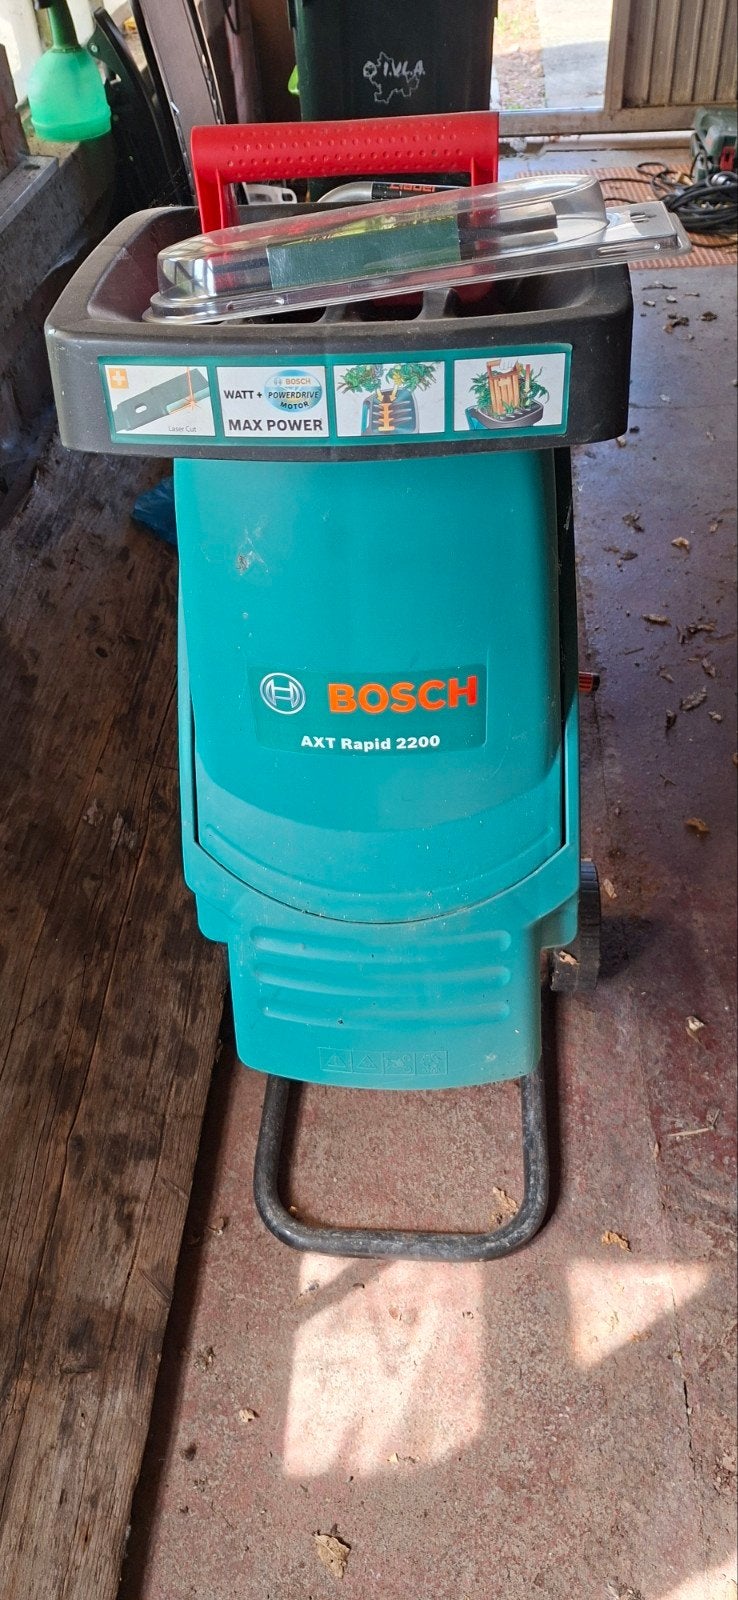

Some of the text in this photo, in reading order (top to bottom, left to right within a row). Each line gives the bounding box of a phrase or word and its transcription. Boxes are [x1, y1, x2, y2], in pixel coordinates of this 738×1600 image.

[223, 390, 254, 399] WATT
[268, 391, 320, 399] POWERDRIVE
[280, 400, 310, 410] MOTOR
[185, 425, 197, 433] Cut
[228, 419, 323, 431] MAX POWER
[327, 675, 478, 715] BOSCH
[300, 734, 441, 753] AXT Rapid 2200
